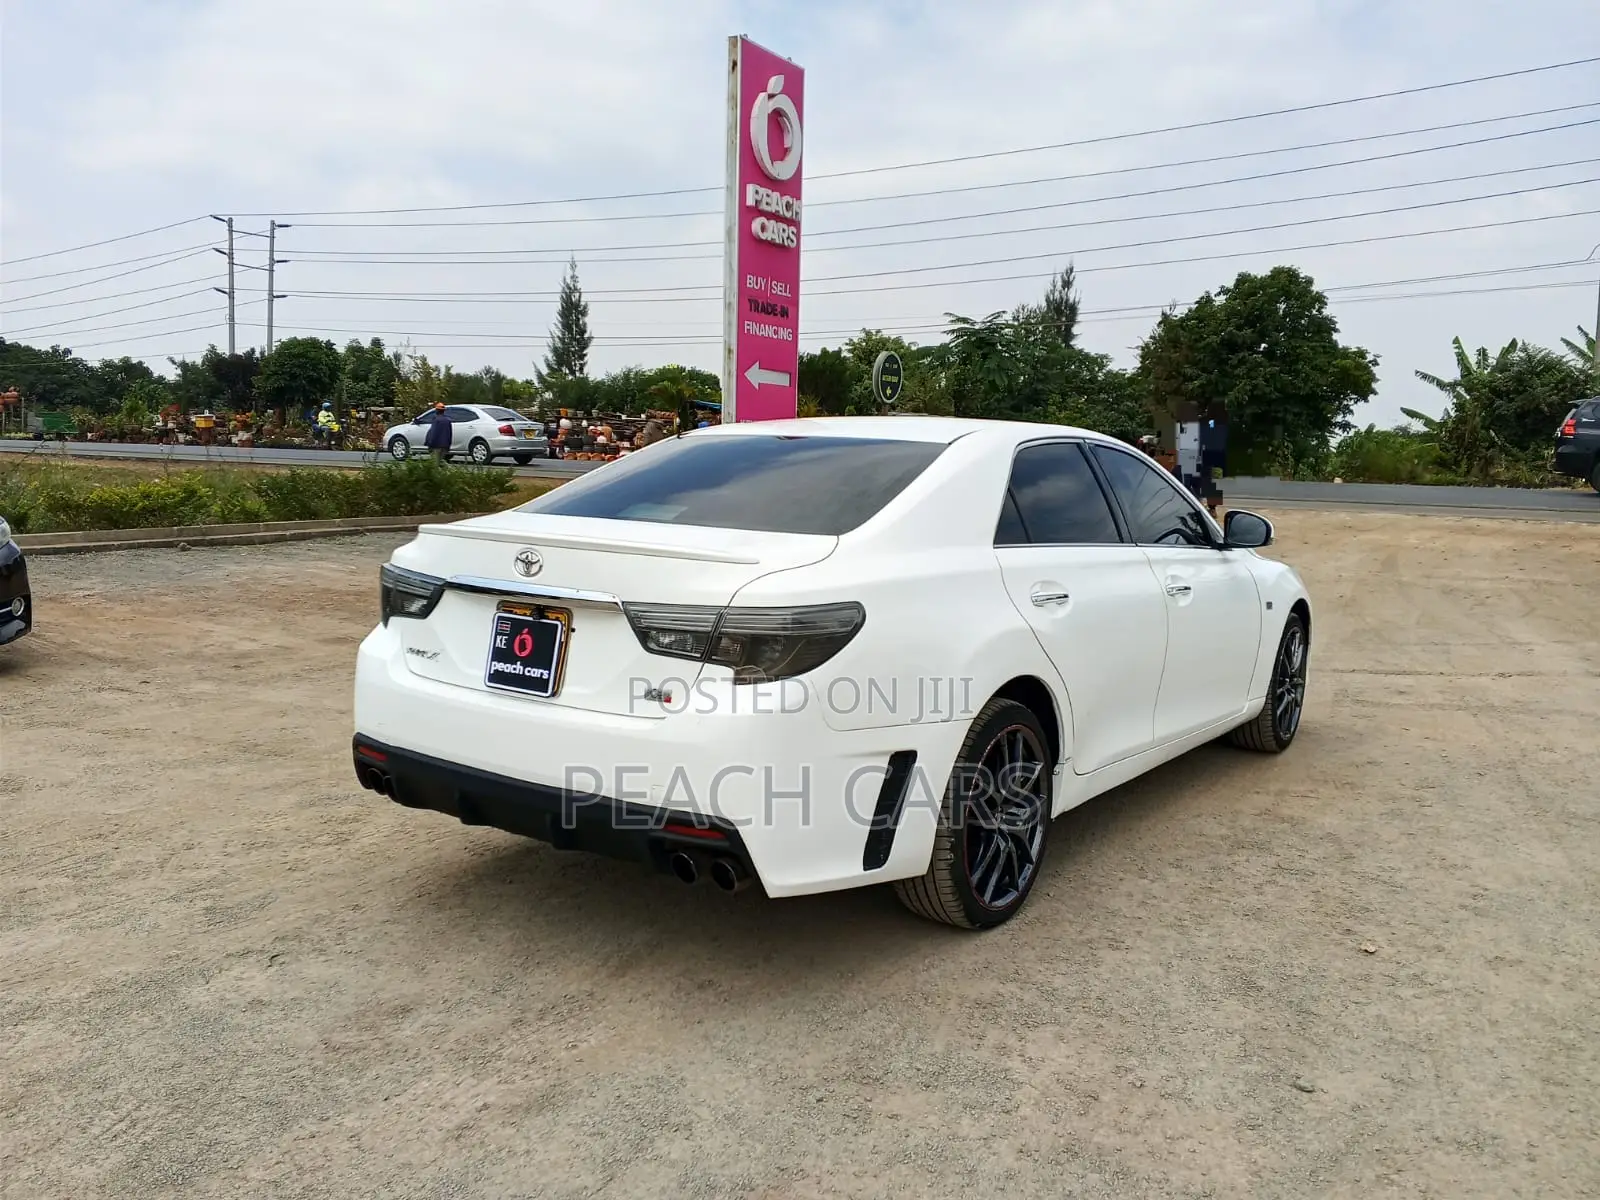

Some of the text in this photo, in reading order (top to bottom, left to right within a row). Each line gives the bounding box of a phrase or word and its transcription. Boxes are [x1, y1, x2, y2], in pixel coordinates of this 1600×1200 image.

[746, 183, 801, 220] PEACH
[751, 216, 797, 248] CARS
[746, 274, 792, 297] BUY SELL
[747, 298, 790, 318] TRADE-IN
[744, 320, 793, 341] FINANCING
[495, 635, 509, 649] KE
[490, 660, 550, 679] peach cars
